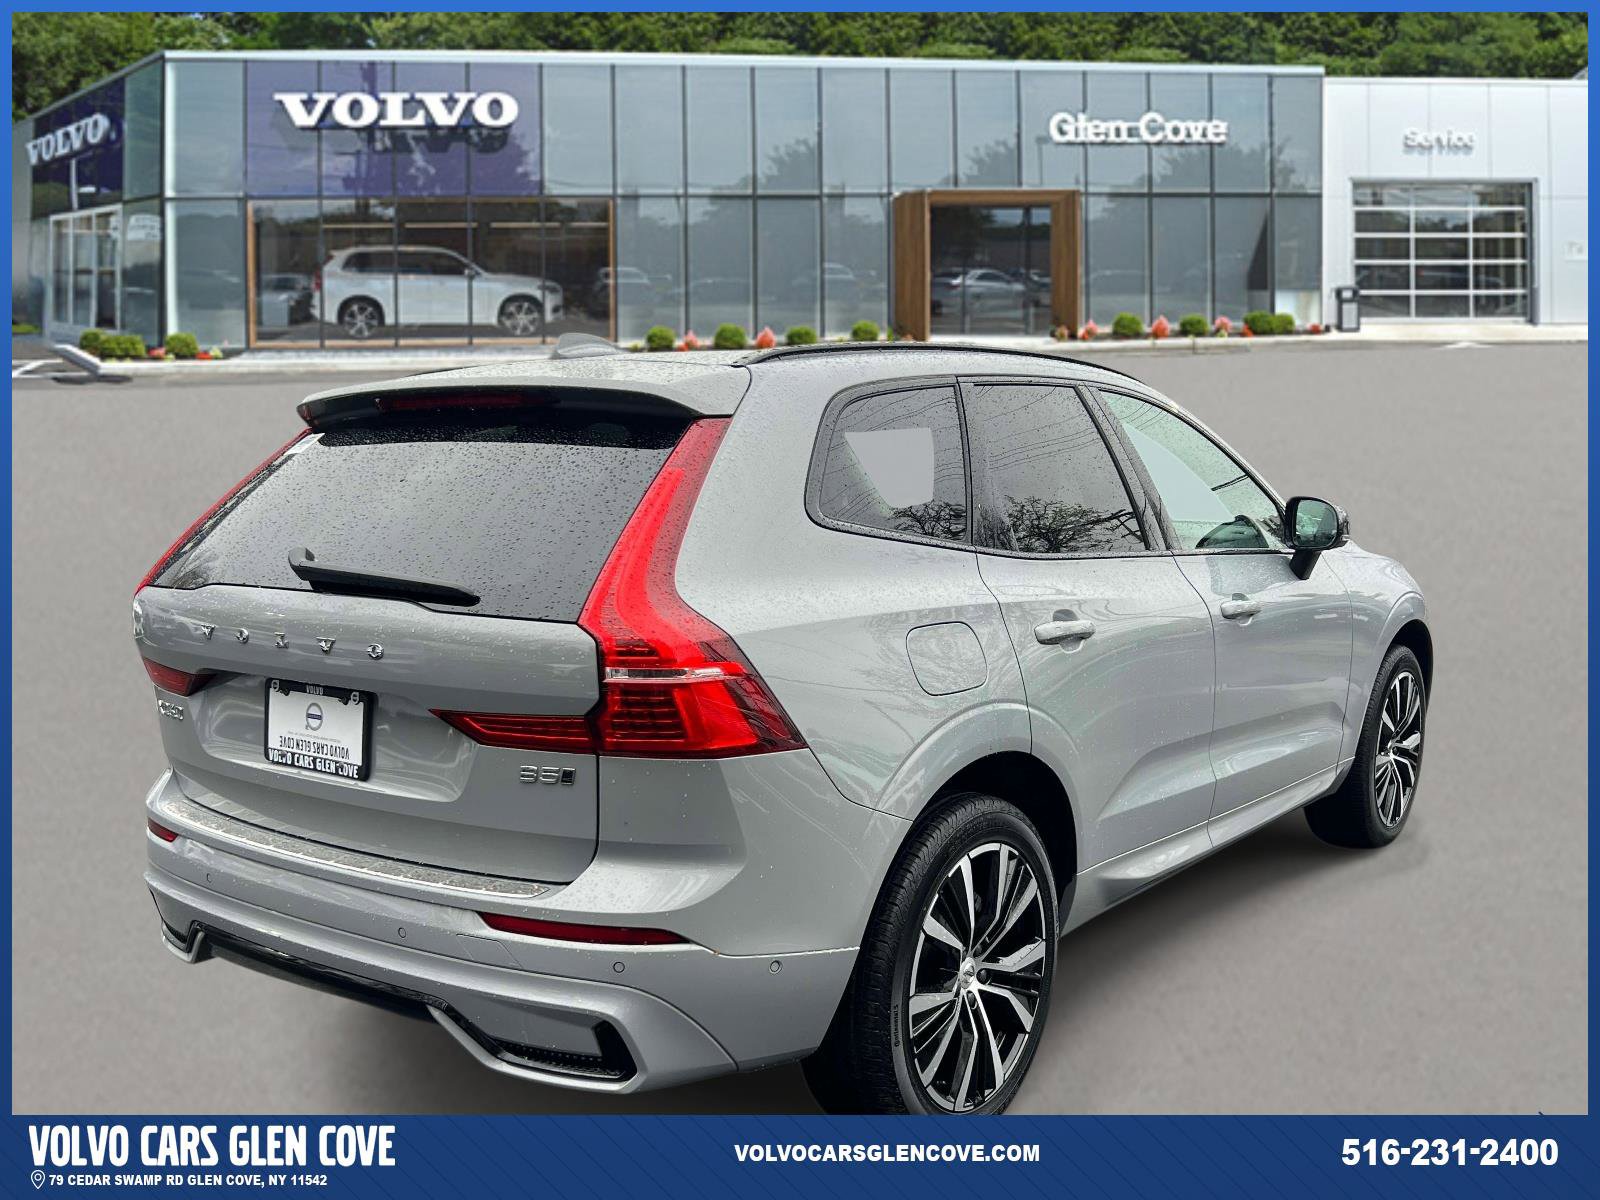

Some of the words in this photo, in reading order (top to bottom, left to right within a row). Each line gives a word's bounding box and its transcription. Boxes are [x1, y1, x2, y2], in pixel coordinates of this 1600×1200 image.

[273, 92, 519, 128] VOLVO
[1050, 112, 1131, 143] Glen
[1139, 112, 1228, 143] Cove
[25, 112, 110, 166] VOLVO
[1402, 127, 1475, 150] Service
[200, 623, 385, 661] VOLVO
[306, 684, 324, 696] VOLVO
[279, 735, 295, 750] COVE
[296, 738, 311, 753] GLEN
[313, 741, 329, 757] CARS
[330, 745, 350, 760] VOLVO
[294, 753, 314, 769] CARS
[316, 758, 336, 774] GLEN
